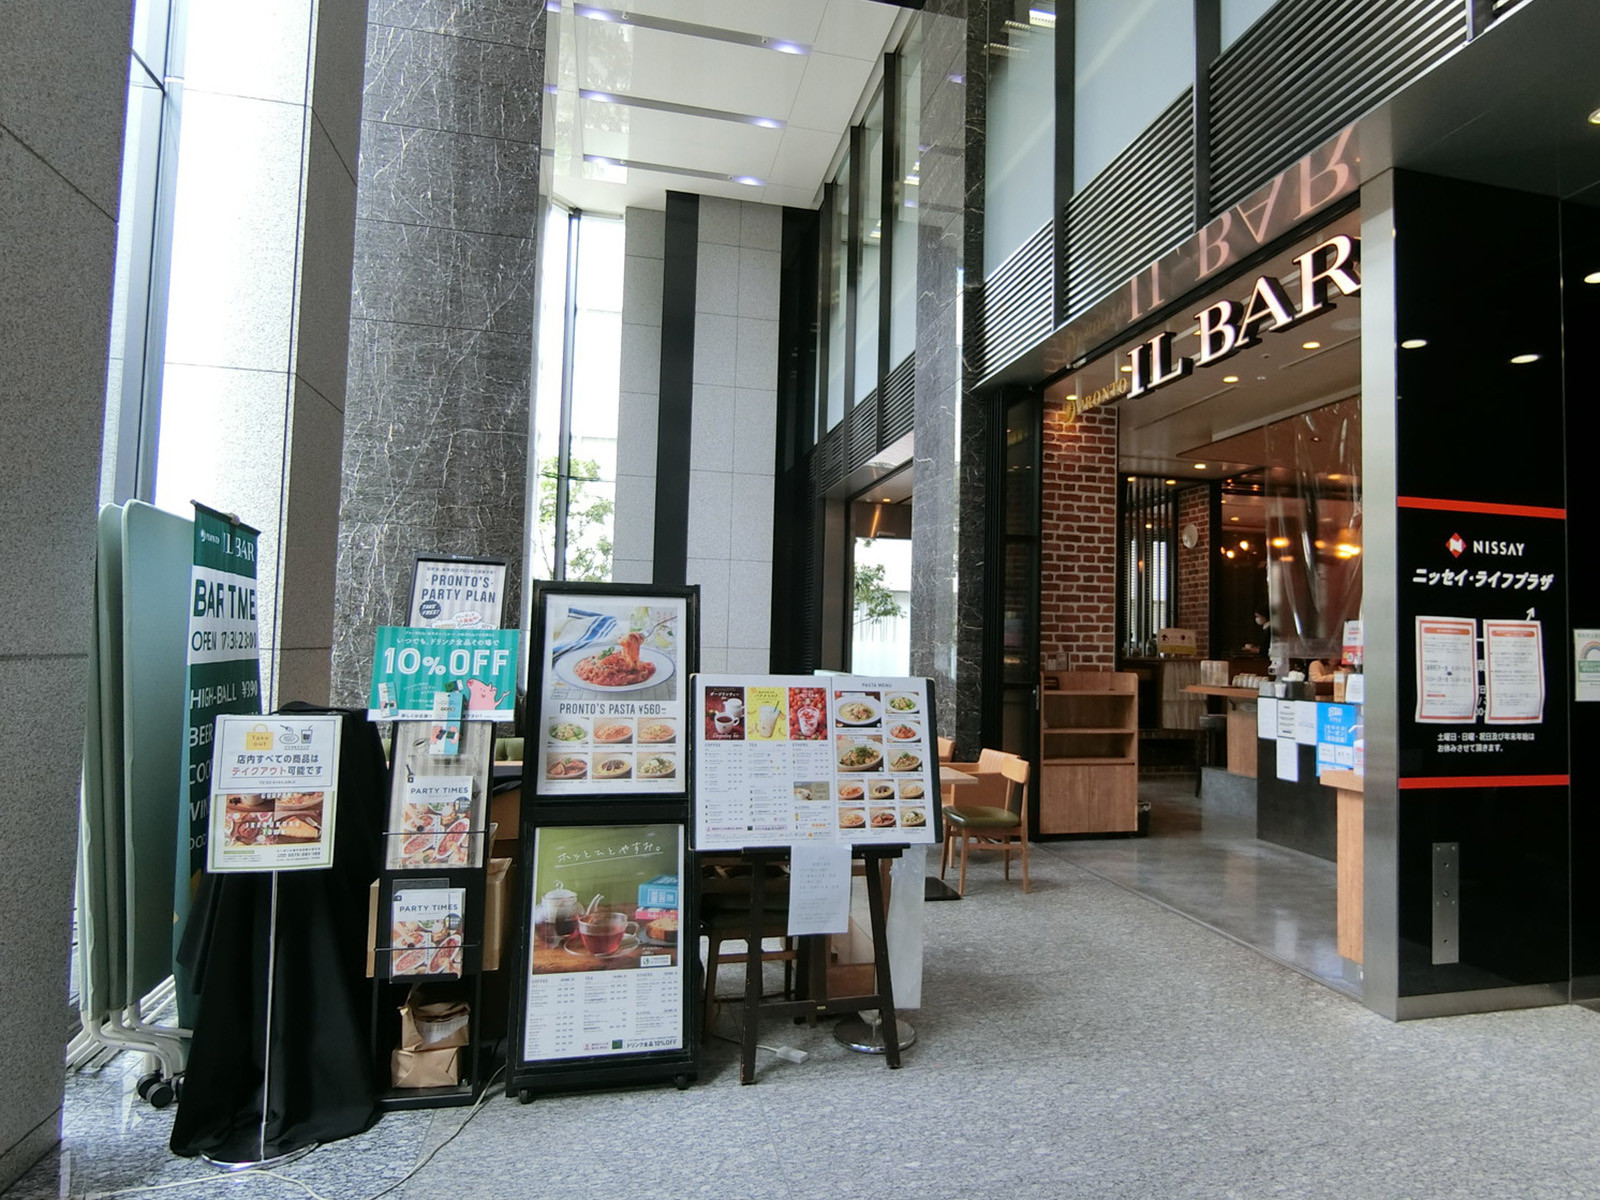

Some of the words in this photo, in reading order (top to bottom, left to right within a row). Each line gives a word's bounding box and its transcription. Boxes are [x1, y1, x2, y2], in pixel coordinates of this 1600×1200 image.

[1126, 332, 1193, 400] IL
[1194, 234, 1362, 367] BAR
[1473, 540, 1525, 556] NISSAY
[431, 574, 489, 588] PRONTO'S
[1412, 568, 1554, 591] ニッセイ・ライフプラザ
[193, 579, 225, 618] BAR
[421, 588, 461, 600] PARTY
[466, 589, 496, 603] PLAN
[191, 631, 217, 651] OPEN
[559, 702, 606, 715] PRONTO'S
[608, 703, 636, 715] PASTA
[189, 723, 214, 748] BEER
[237, 754, 319, 765] 店内すべての商品は
[231, 766, 323, 777] テイクアウト可能です
[410, 787, 440, 795] PARTY
[443, 786, 469, 794] TIMES
[399, 904, 429, 912] PARTY
[432, 903, 459, 911] TIMES
